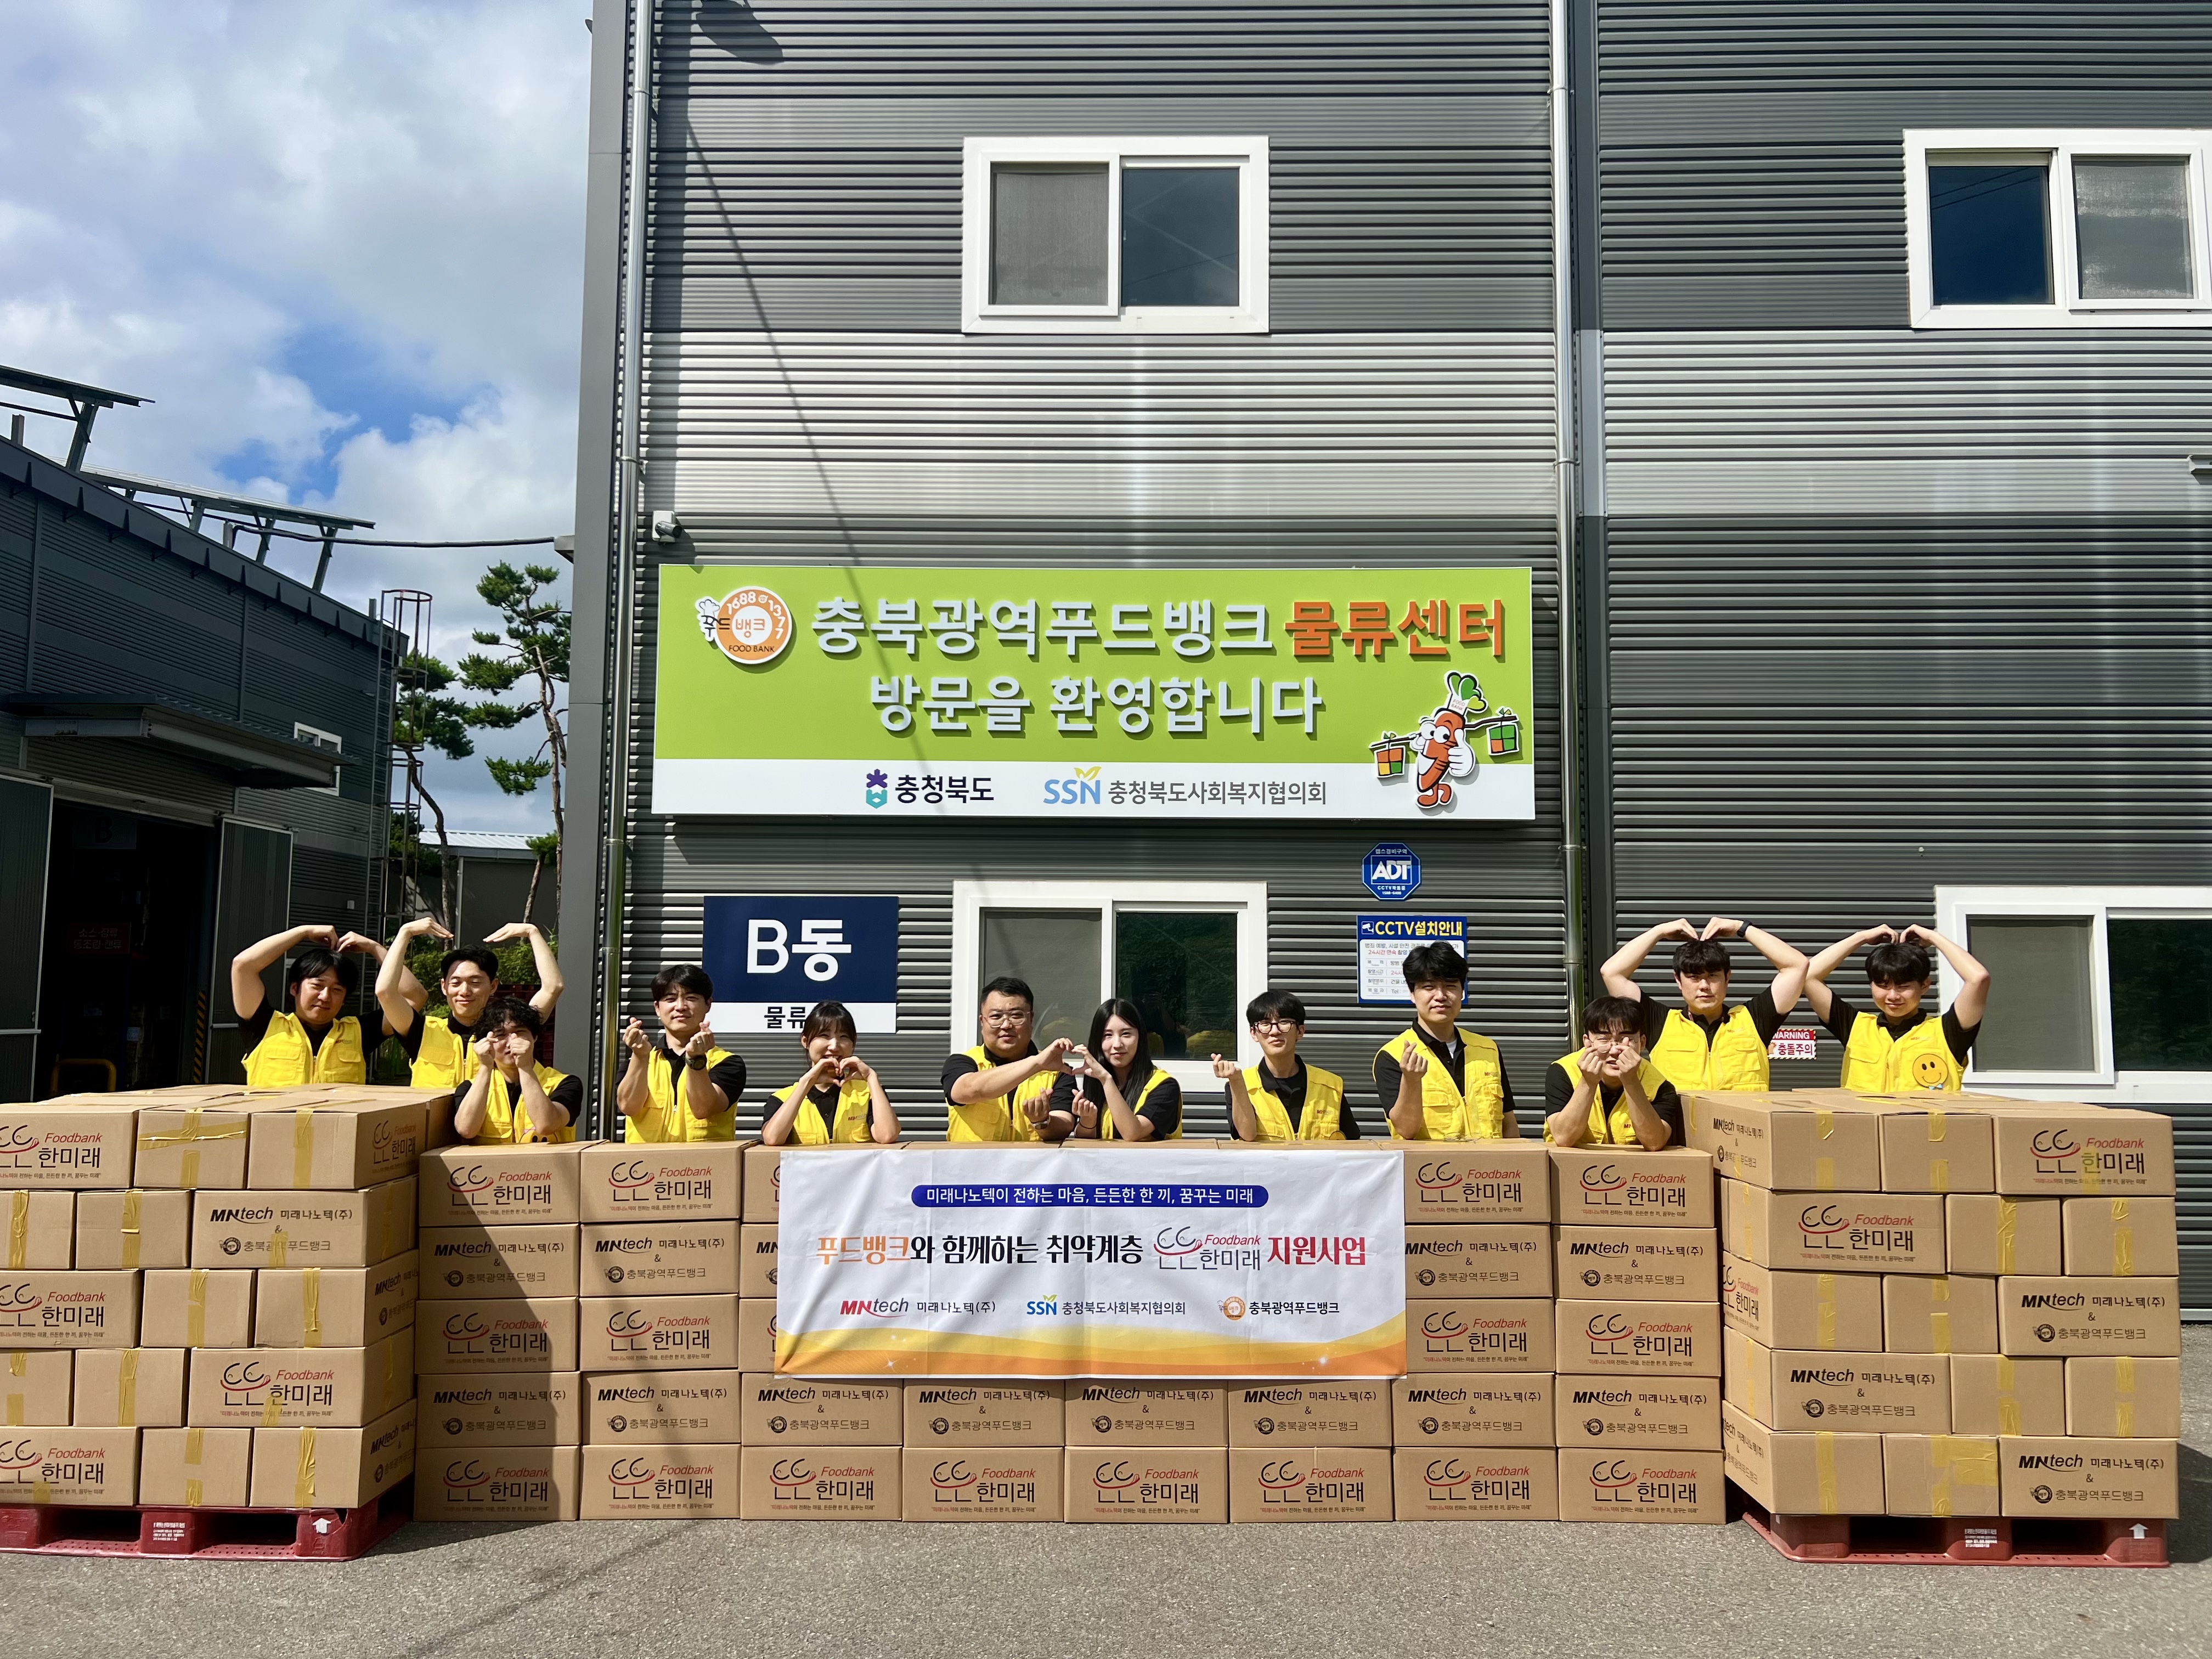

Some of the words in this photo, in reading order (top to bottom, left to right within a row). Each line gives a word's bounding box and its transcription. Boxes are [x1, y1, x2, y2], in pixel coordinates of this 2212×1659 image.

[726, 591, 757, 615] 1688
[768, 600, 786, 640] 1377
[735, 618, 766, 639] 뱅크
[812, 596, 1273, 656] 충북광역푸드뱅크
[1284, 599, 1504, 657] 물류센터
[729, 645, 752, 653] FOOD
[753, 645, 775, 653] BANK
[871, 675, 1030, 732] 방문을
[1049, 675, 1322, 735] 환영합니다
[895, 775, 995, 803] 충청북도
[1043, 778, 1101, 805] SSN
[1108, 780, 1327, 806] 충청북도사회복지협의회
[1372, 860, 1412, 880] ADT
[1375, 921, 1463, 936] CCTV설치안내
[747, 919, 852, 981] B동
[1778, 1043, 1813, 1055] 충돌주의
[44, 1132, 103, 1143] Foodbank
[2085, 1137, 2145, 1149] Foodbank
[498, 1171, 552, 1182] Foodbank
[659, 1166, 713, 1177] Foodbank
[1467, 1169, 1522, 1179] Foodbank
[1632, 1172, 1687, 1184] Foodbank
[927, 1187, 1008, 1204] 미래나노텍이
[1013, 1188, 1053, 1203] 전하는
[1058, 1188, 1090, 1204] 마음,
[1094, 1188, 1136, 1204] 든든한
[1140, 1188, 1153, 1203] 한
[1158, 1189, 1175, 1204] 끼,
[1180, 1188, 1221, 1204] 꿈꾸는
[1227, 1189, 1252, 1204] 미래
[210, 1206, 274, 1222] MNtech
[280, 1209, 353, 1221] 미래나노텍(주)
[1854, 1214, 1915, 1226] Foodbank
[595, 1237, 653, 1252] MNtech
[658, 1238, 725, 1250] 미래나노텍(주)
[1204, 1234, 1261, 1245] Foodbank
[1404, 1237, 1463, 1254] MNtech
[1469, 1242, 1537, 1254] 미래나노텍(주)
[817, 1235, 935, 1265] 푸드뱅크와
[943, 1235, 1038, 1263] 함께하는
[1046, 1234, 1143, 1263] 취약계층
[1268, 1237, 1365, 1265] 지원사업
[1570, 1241, 1629, 1255] MNtech
[1635, 1245, 1703, 1257] 미래나노텍(주)
[627, 1267, 707, 1280] 충북광역푸드뱅크
[1438, 1272, 1519, 1283] 충북광역푸드뱅크
[1602, 1273, 1685, 1285] 충북광역푸드뱅크
[46, 1291, 106, 1302] Foodbank
[2021, 1293, 2085, 1308] MNtech
[2091, 1296, 2165, 1310] 미래나노텍(주)
[840, 1298, 909, 1316] MNtech
[917, 1301, 996, 1313] 미래나노텍(주)
[1027, 1301, 1057, 1315] SSN
[1062, 1301, 1185, 1315] 충청북도사회복지협의회
[1249, 1302, 1339, 1314] 충북광역푸드뱅크
[494, 1318, 549, 1333] Foodbank
[657, 1315, 711, 1327] Foodbank
[1472, 1318, 1528, 1328] Foodbank
[1638, 1322, 1693, 1333] Foodbank
[2057, 1328, 2147, 1340] 충북광역푸드뱅크
[275, 1369, 335, 1381] Foodbank
[1790, 1368, 1854, 1383] MNtech
[1861, 1373, 1935, 1386] 미래나노텍(주)
[597, 1386, 655, 1401] MNtech
[661, 1388, 727, 1400] 미래나노텍(주)
[758, 1387, 815, 1401] MNtech
[822, 1390, 888, 1401] 미래나노텍(주)
[919, 1388, 977, 1403] MNtech
[984, 1391, 1050, 1401] 미래나노텍(주)
[1082, 1387, 1140, 1401] MNtech
[1147, 1391, 1214, 1401] 미래나노텍(주)
[1244, 1388, 1302, 1403] MNtech
[1310, 1391, 1376, 1402] 미래나노텍(주)
[1408, 1387, 1467, 1402] MNtech
[1473, 1391, 1541, 1403] 미래나노텍(주)
[1572, 1389, 1632, 1403] MNtech
[1638, 1393, 1707, 1406] 미래나노텍(주)
[1826, 1403, 1916, 1417] 충북광역푸드뱅크
[629, 1418, 709, 1429] 충북광역푸드뱅크
[790, 1420, 870, 1430] 충북광역푸드뱅크
[952, 1420, 1031, 1431] 충북광역푸드뱅크
[1114, 1419, 1195, 1430] 충북광역푸드뱅크
[1277, 1420, 1358, 1431] 충북광역푸드뱅크
[1441, 1420, 1523, 1432] 충북광역푸드뱅크
[1606, 1422, 1689, 1435] 충북광역푸드뱅크
[47, 1447, 106, 1459] Foodbank
[2018, 1454, 2083, 1469] MNtech
[2090, 1458, 2164, 1471] 미래나노텍(주)
[494, 1467, 550, 1478] Foodbank
[659, 1464, 714, 1476] Foodbank
[821, 1466, 875, 1477] Foodbank
[981, 1468, 1036, 1479] Foodbank
[1144, 1469, 1200, 1479] Foodbank
[1310, 1467, 1365, 1479] Foodbank
[1475, 1465, 1530, 1476] Foodbank
[1641, 1468, 1698, 1479] Foodbank
[2055, 1489, 2145, 1502] 충북광역푸드뱅크
